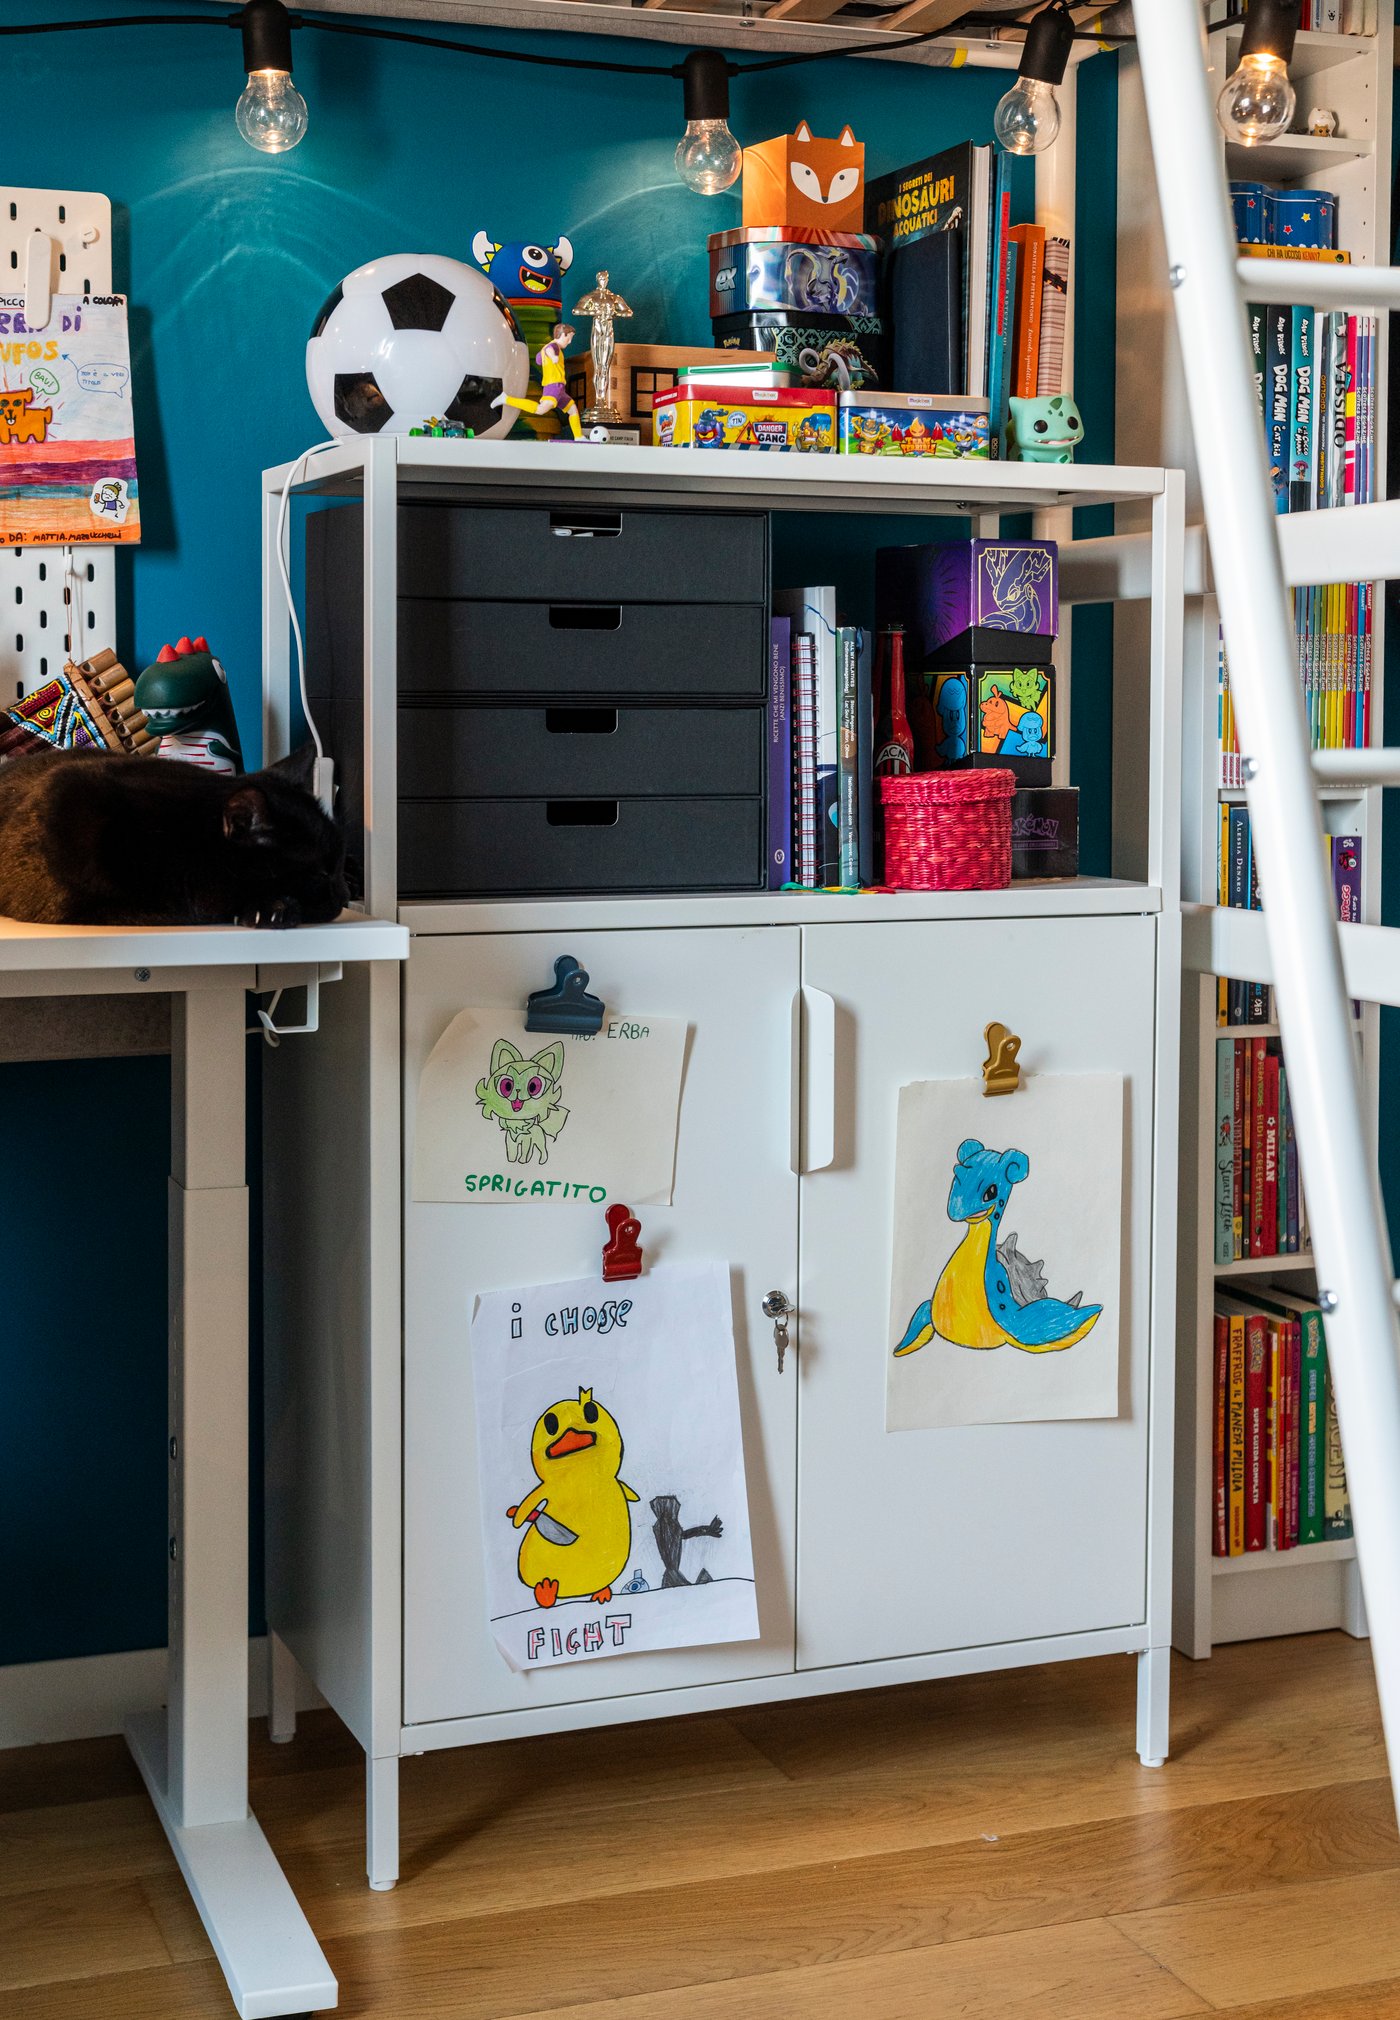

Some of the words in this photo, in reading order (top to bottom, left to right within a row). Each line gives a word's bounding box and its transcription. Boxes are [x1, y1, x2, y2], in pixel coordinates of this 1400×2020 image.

[902, 176, 923, 192] SEGRETI
[924, 172, 933, 184] DEI
[893, 208, 938, 238] ACQUATICI
[1267, 248, 1276, 258] CHI
[1276, 249, 1284, 258] HA
[1284, 250, 1301, 260] UCCISO
[1302, 251, 1320, 261] KENNY?
[1272, 364, 1288, 392] DOG
[1297, 366, 1311, 394] DOG
[1273, 394, 1288, 422] MAN
[1297, 396, 1310, 424] MAN
[1334, 361, 1346, 449] ODISSEA
[732, 417, 744, 425] TIN
[757, 424, 784, 433] DANGER
[758, 433, 786, 444] GANG
[900, 443, 936, 455] TERRIBLE
[904, 436, 932, 444] TEAM
[880, 746, 906, 760] ACM
[607, 1022, 650, 1040] ERBA
[1266, 1129, 1276, 1182] MILAN
[464, 1174, 607, 1203] SPRIGATITO
[1219, 1160, 1234, 1201] Stuart
[1255, 1152, 1263, 1221] CREEPYPELLE
[1232, 1328, 1242, 1385] FRAFFROG
[1231, 1401, 1243, 1445] PIANETA
[1231, 1450, 1243, 1492] PILLOLA
[528, 1614, 632, 1660] FIGHT
